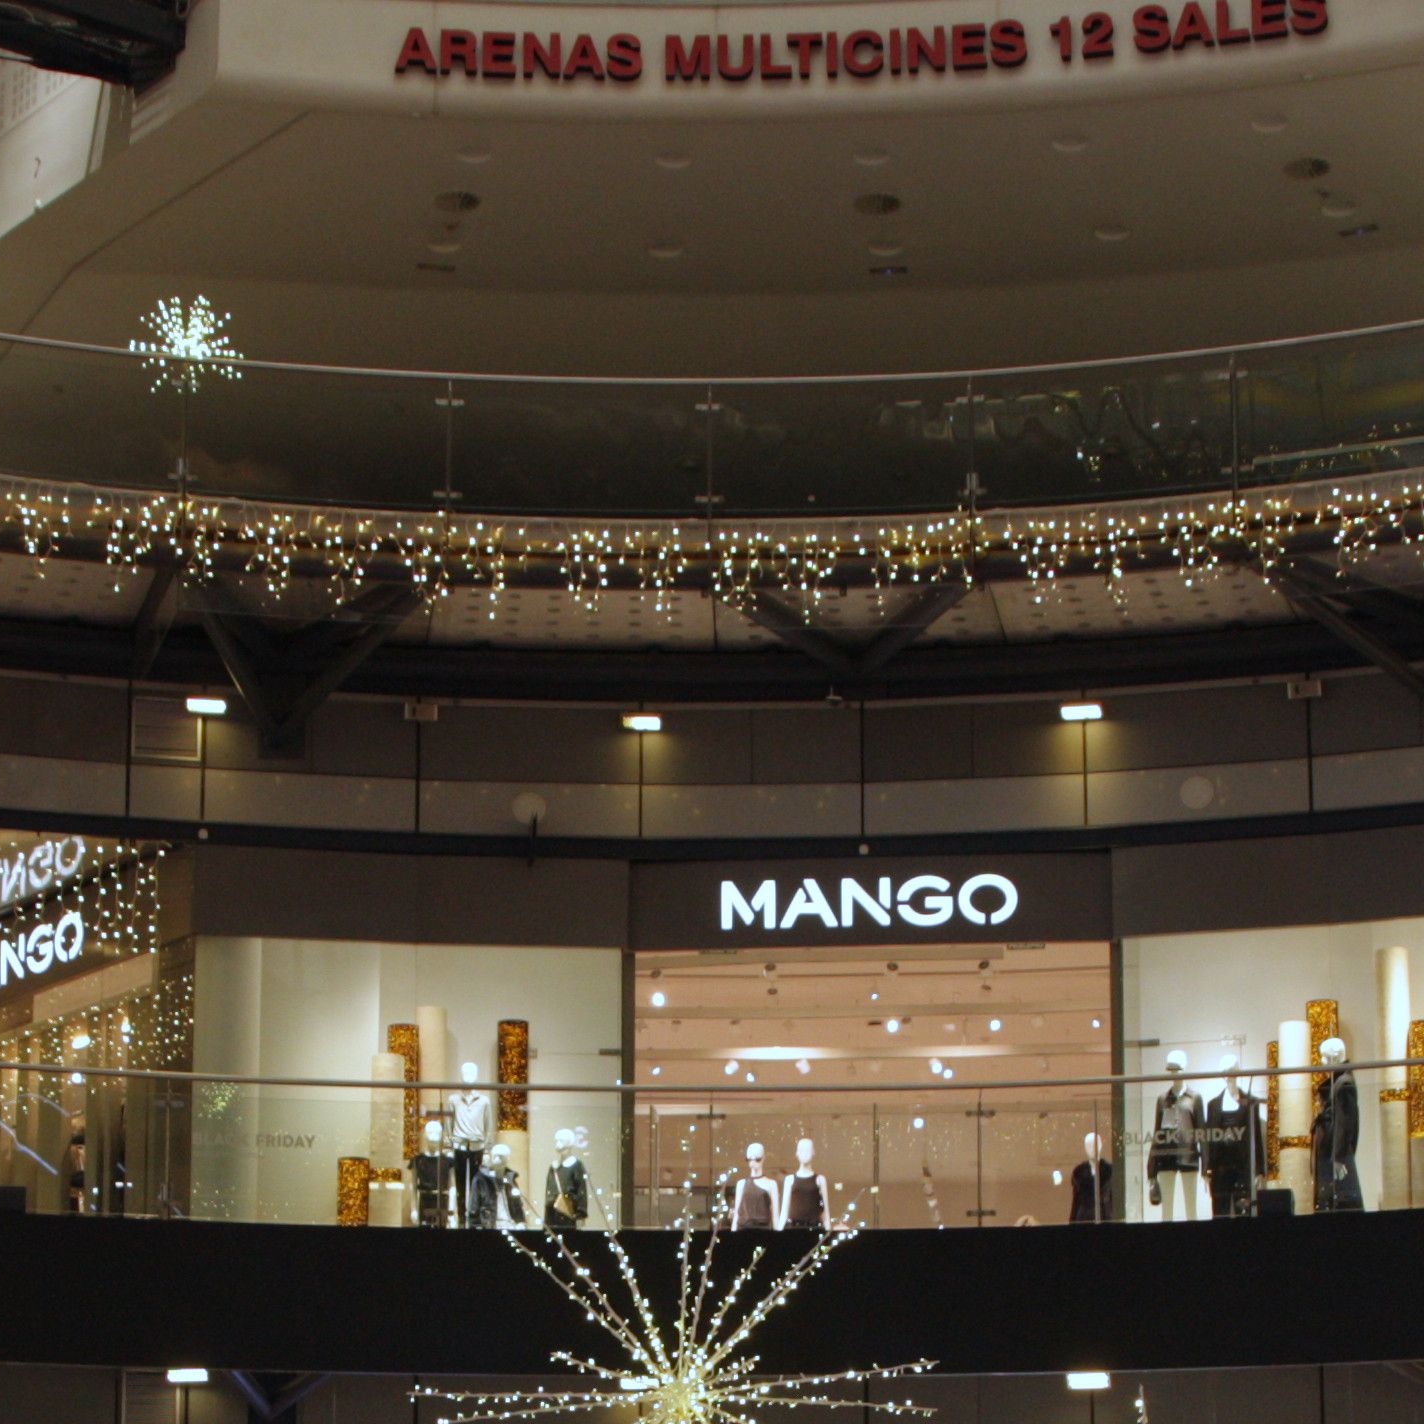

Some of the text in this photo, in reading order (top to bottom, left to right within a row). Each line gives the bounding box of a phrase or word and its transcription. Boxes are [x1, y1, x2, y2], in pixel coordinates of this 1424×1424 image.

[395, 0, 1328, 82] ARENAS MULTICINES 12 SALES
[720, 873, 1018, 930] MANGO
[255, 1134, 316, 1148] FRIDAY
[1123, 1126, 1246, 1145] BLACK FRIDAY
